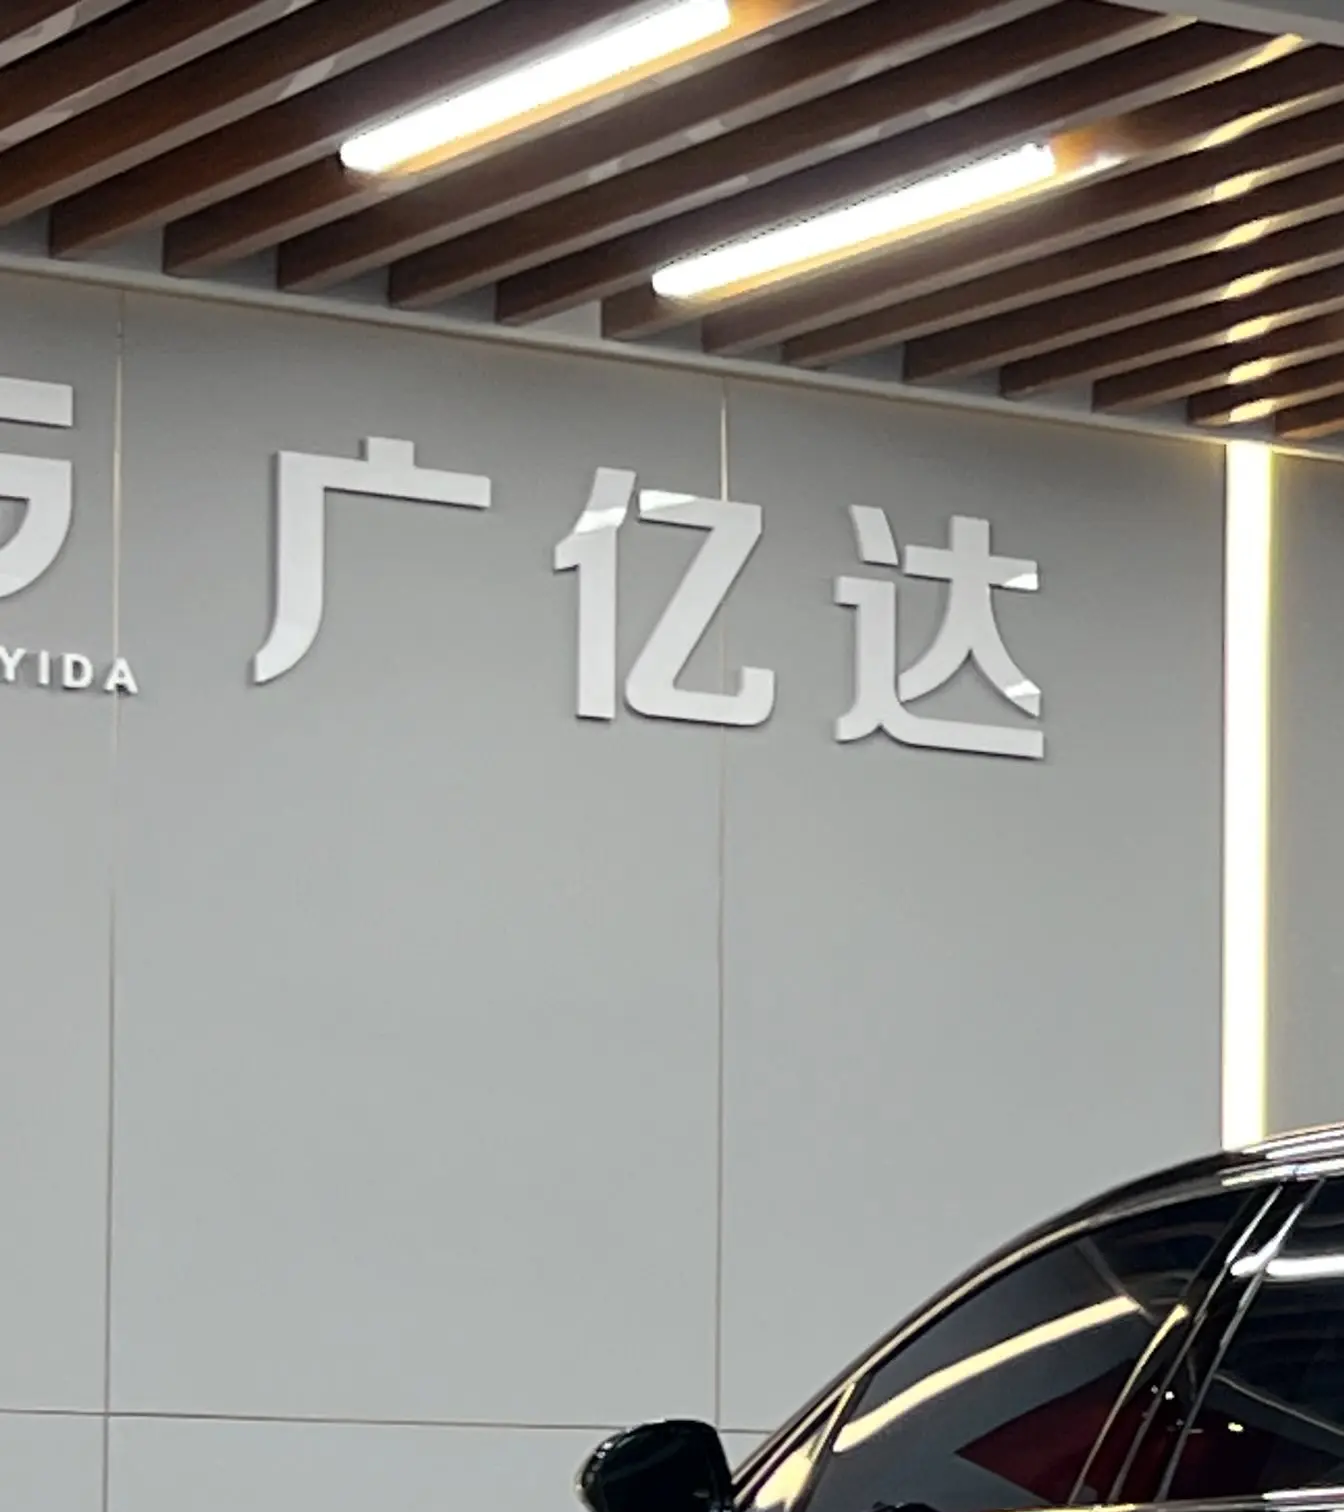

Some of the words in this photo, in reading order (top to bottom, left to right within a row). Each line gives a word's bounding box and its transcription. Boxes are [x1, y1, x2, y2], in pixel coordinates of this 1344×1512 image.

[0, 645, 138, 694] YIDA
[252, 436, 1046, 760] 广亿达
